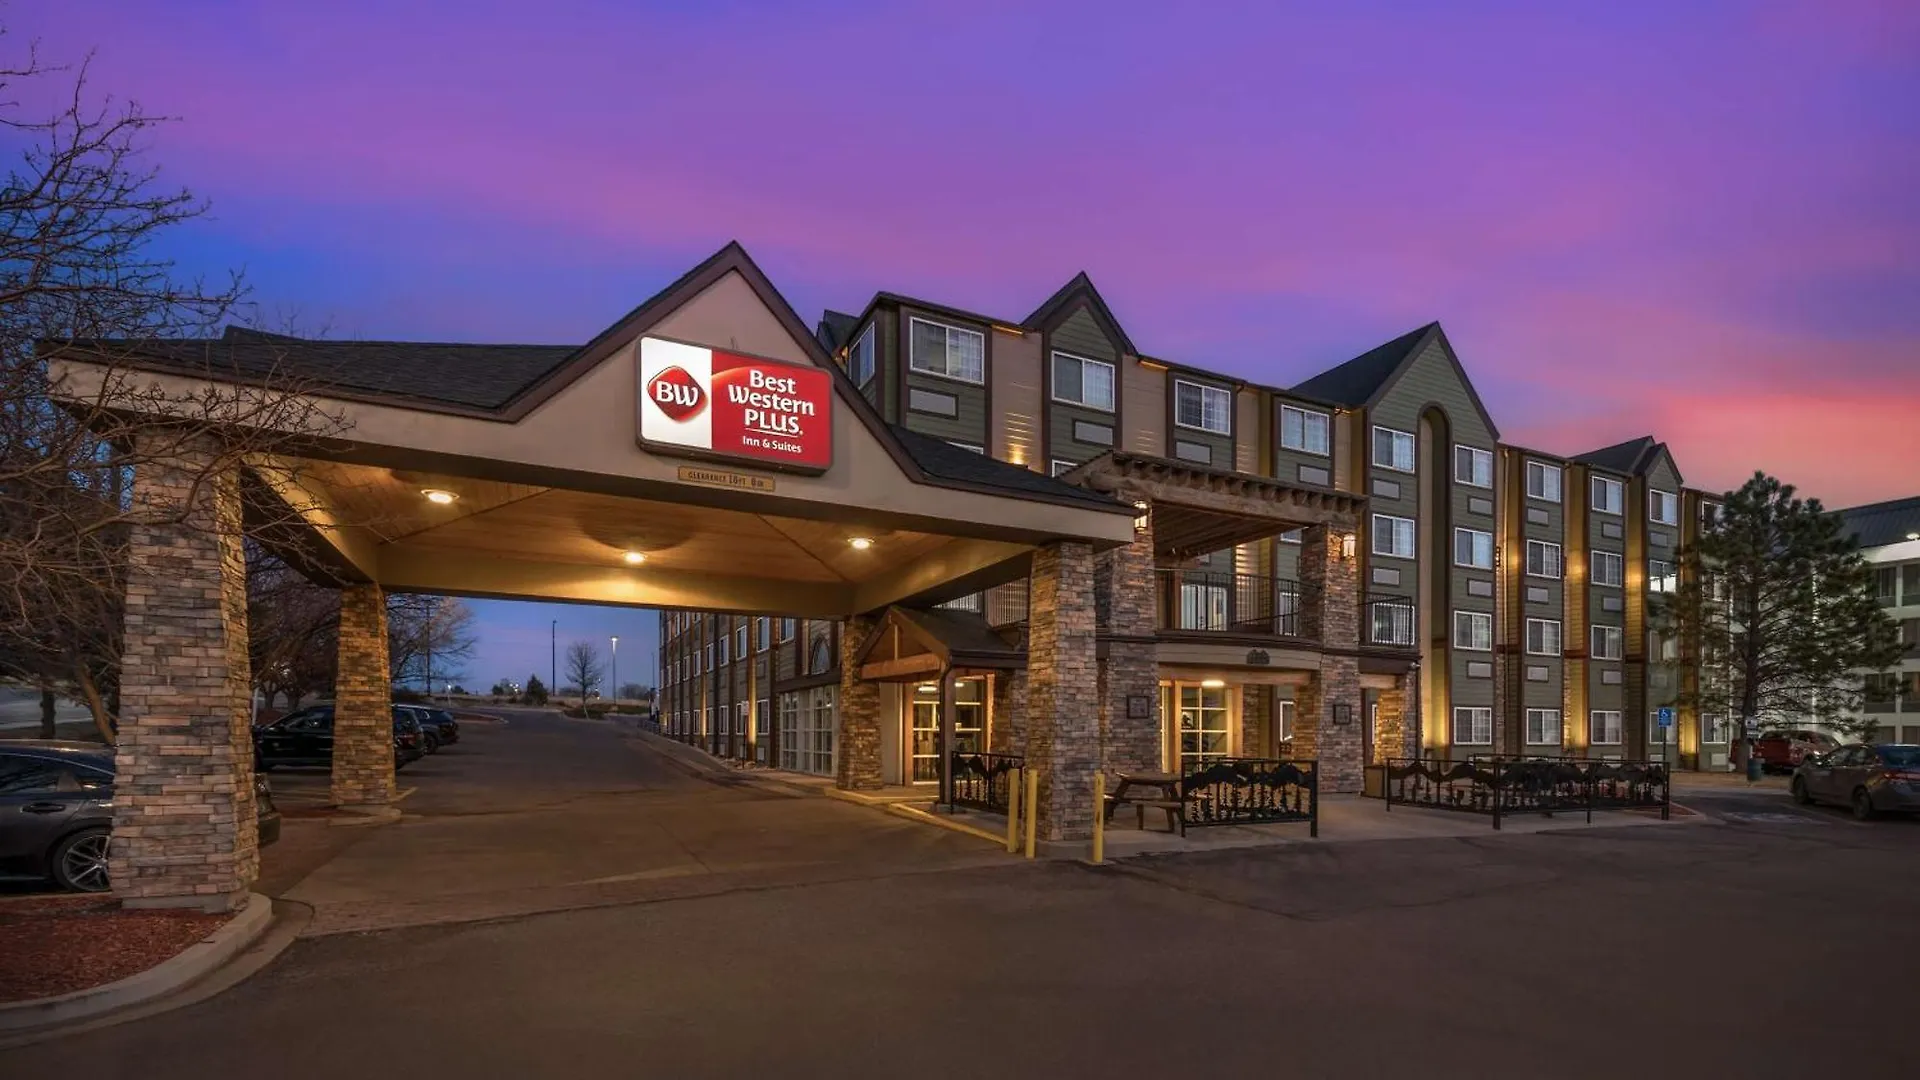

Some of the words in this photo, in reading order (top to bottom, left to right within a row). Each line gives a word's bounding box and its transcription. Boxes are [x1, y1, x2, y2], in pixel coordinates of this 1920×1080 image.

[656, 381, 699, 407] BW
[749, 369, 797, 394] Best
[728, 384, 815, 416] Western
[743, 435, 760, 447] Inn
[762, 439, 770, 448] &
[772, 440, 802, 453] Suites
